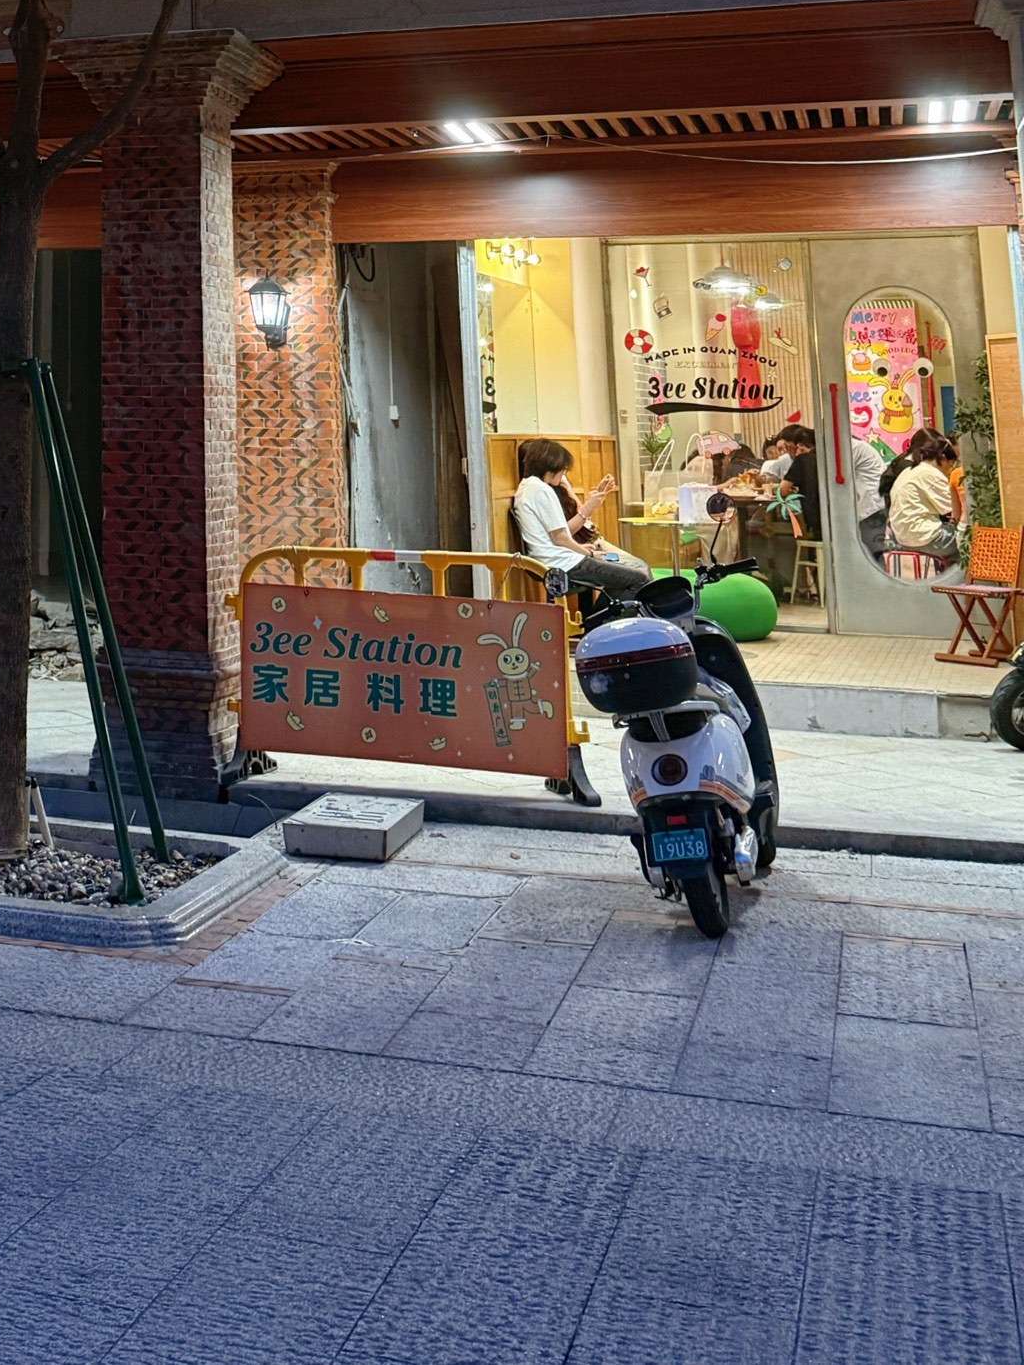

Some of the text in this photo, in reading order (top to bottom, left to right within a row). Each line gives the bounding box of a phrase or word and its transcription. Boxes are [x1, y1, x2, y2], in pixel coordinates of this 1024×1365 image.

[644, 346, 777, 367] MADE IN QUAN ZHOU
[648, 376, 776, 400] 3ee Station
[250, 622, 462, 669] 3ee Station
[252, 664, 458, 718] 家居料理
[659, 840, 705, 860] 19U38
